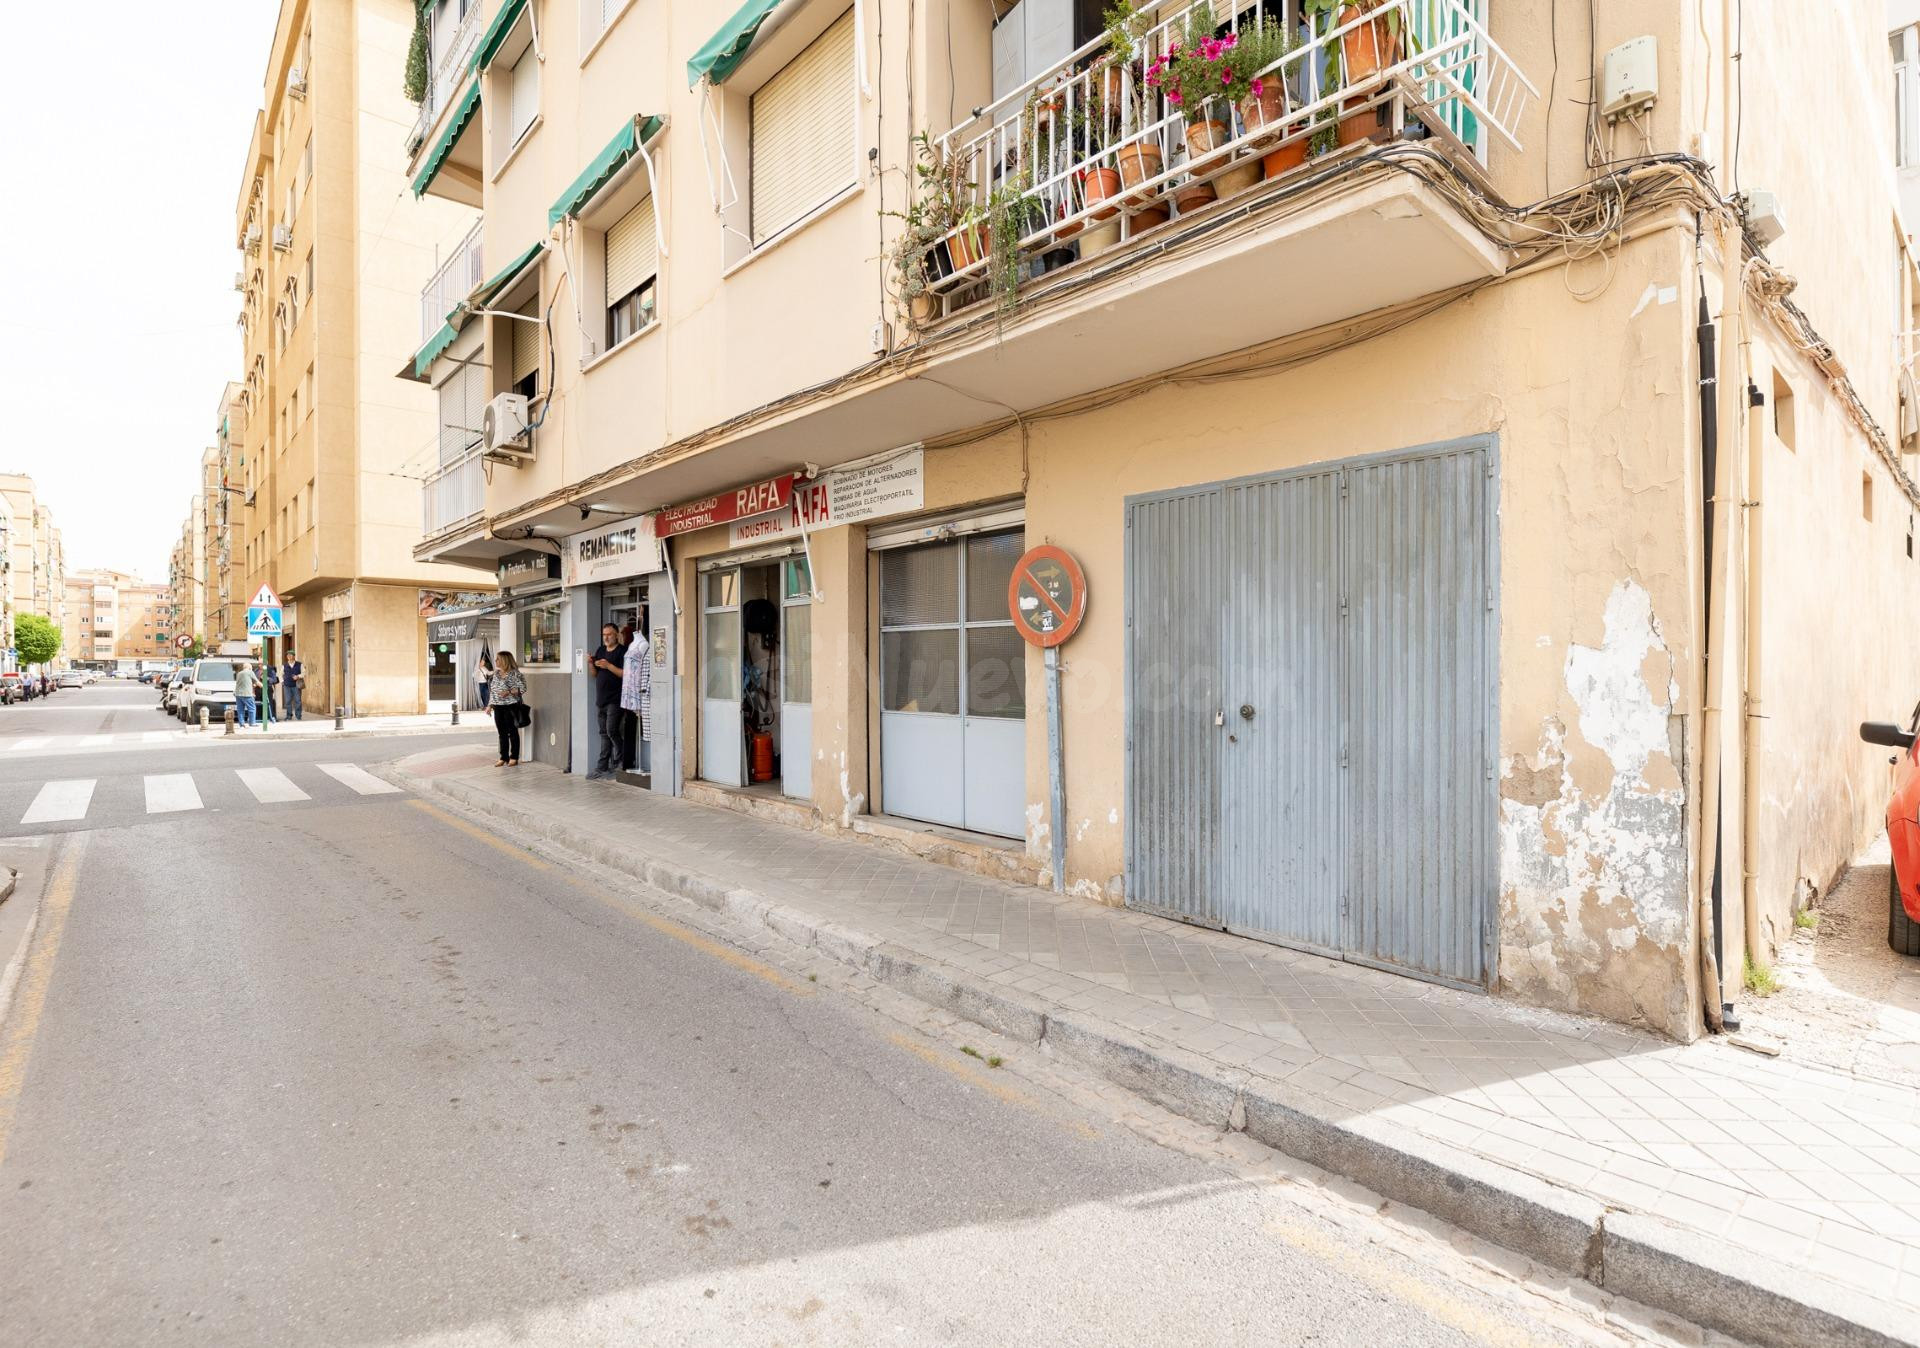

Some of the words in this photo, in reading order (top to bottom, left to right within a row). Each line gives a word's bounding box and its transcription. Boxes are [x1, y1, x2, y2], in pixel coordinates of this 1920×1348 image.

[833, 474, 858, 486] BOBINADO
[859, 470, 866, 479] DE
[867, 465, 893, 476] MOTORES
[865, 479, 873, 487] DE
[874, 469, 917, 483] ALTERNADORES
[665, 498, 718, 520] ELECTRICIDAD
[736, 480, 780, 517] RAFA
[833, 493, 853, 504] BOMBAS
[862, 487, 877, 497] AGUA
[833, 500, 862, 513] MAQUINARIA
[845, 508, 872, 518] INDUSTRIAL
[669, 512, 715, 533] INDUSTRIAL
[736, 518, 783, 541] INDUSTRIAL
[579, 527, 637, 563] REMANENTE
